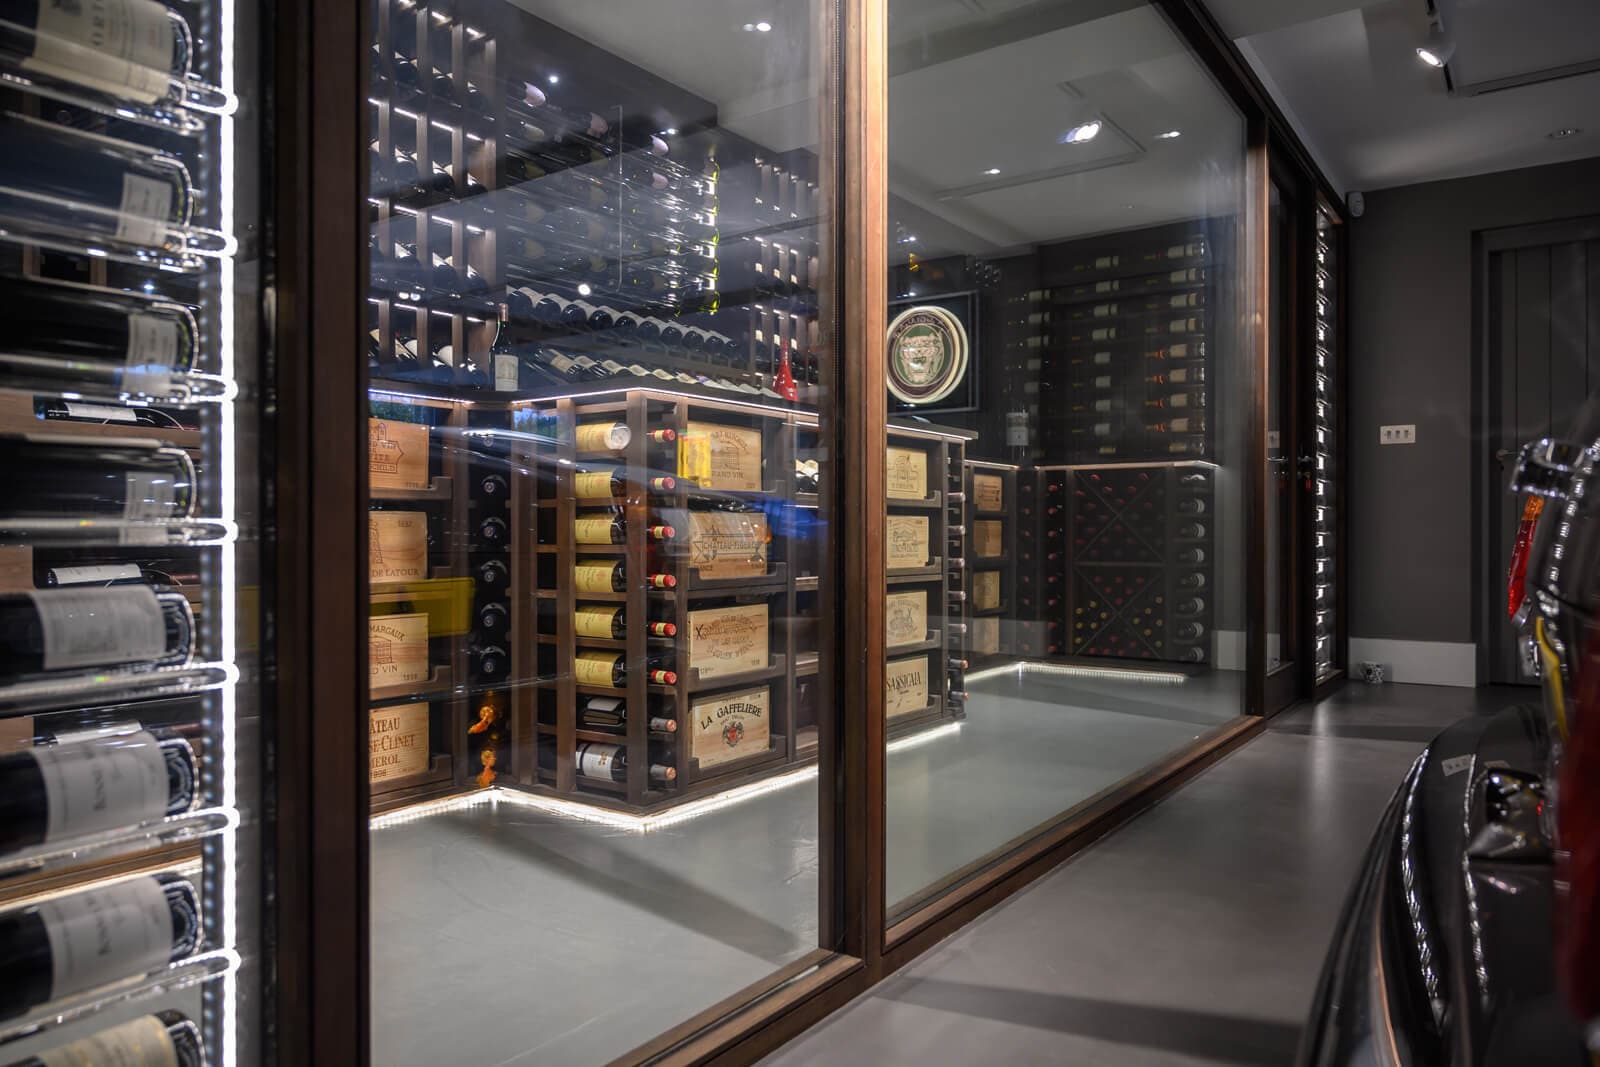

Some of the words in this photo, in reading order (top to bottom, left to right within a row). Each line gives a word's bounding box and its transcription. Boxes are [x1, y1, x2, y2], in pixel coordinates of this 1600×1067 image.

[385, 568, 419, 577] LATOUR
[382, 664, 398, 673] VIN
[700, 715, 713, 730] LA
[716, 702, 763, 719] GAFFELIERE
